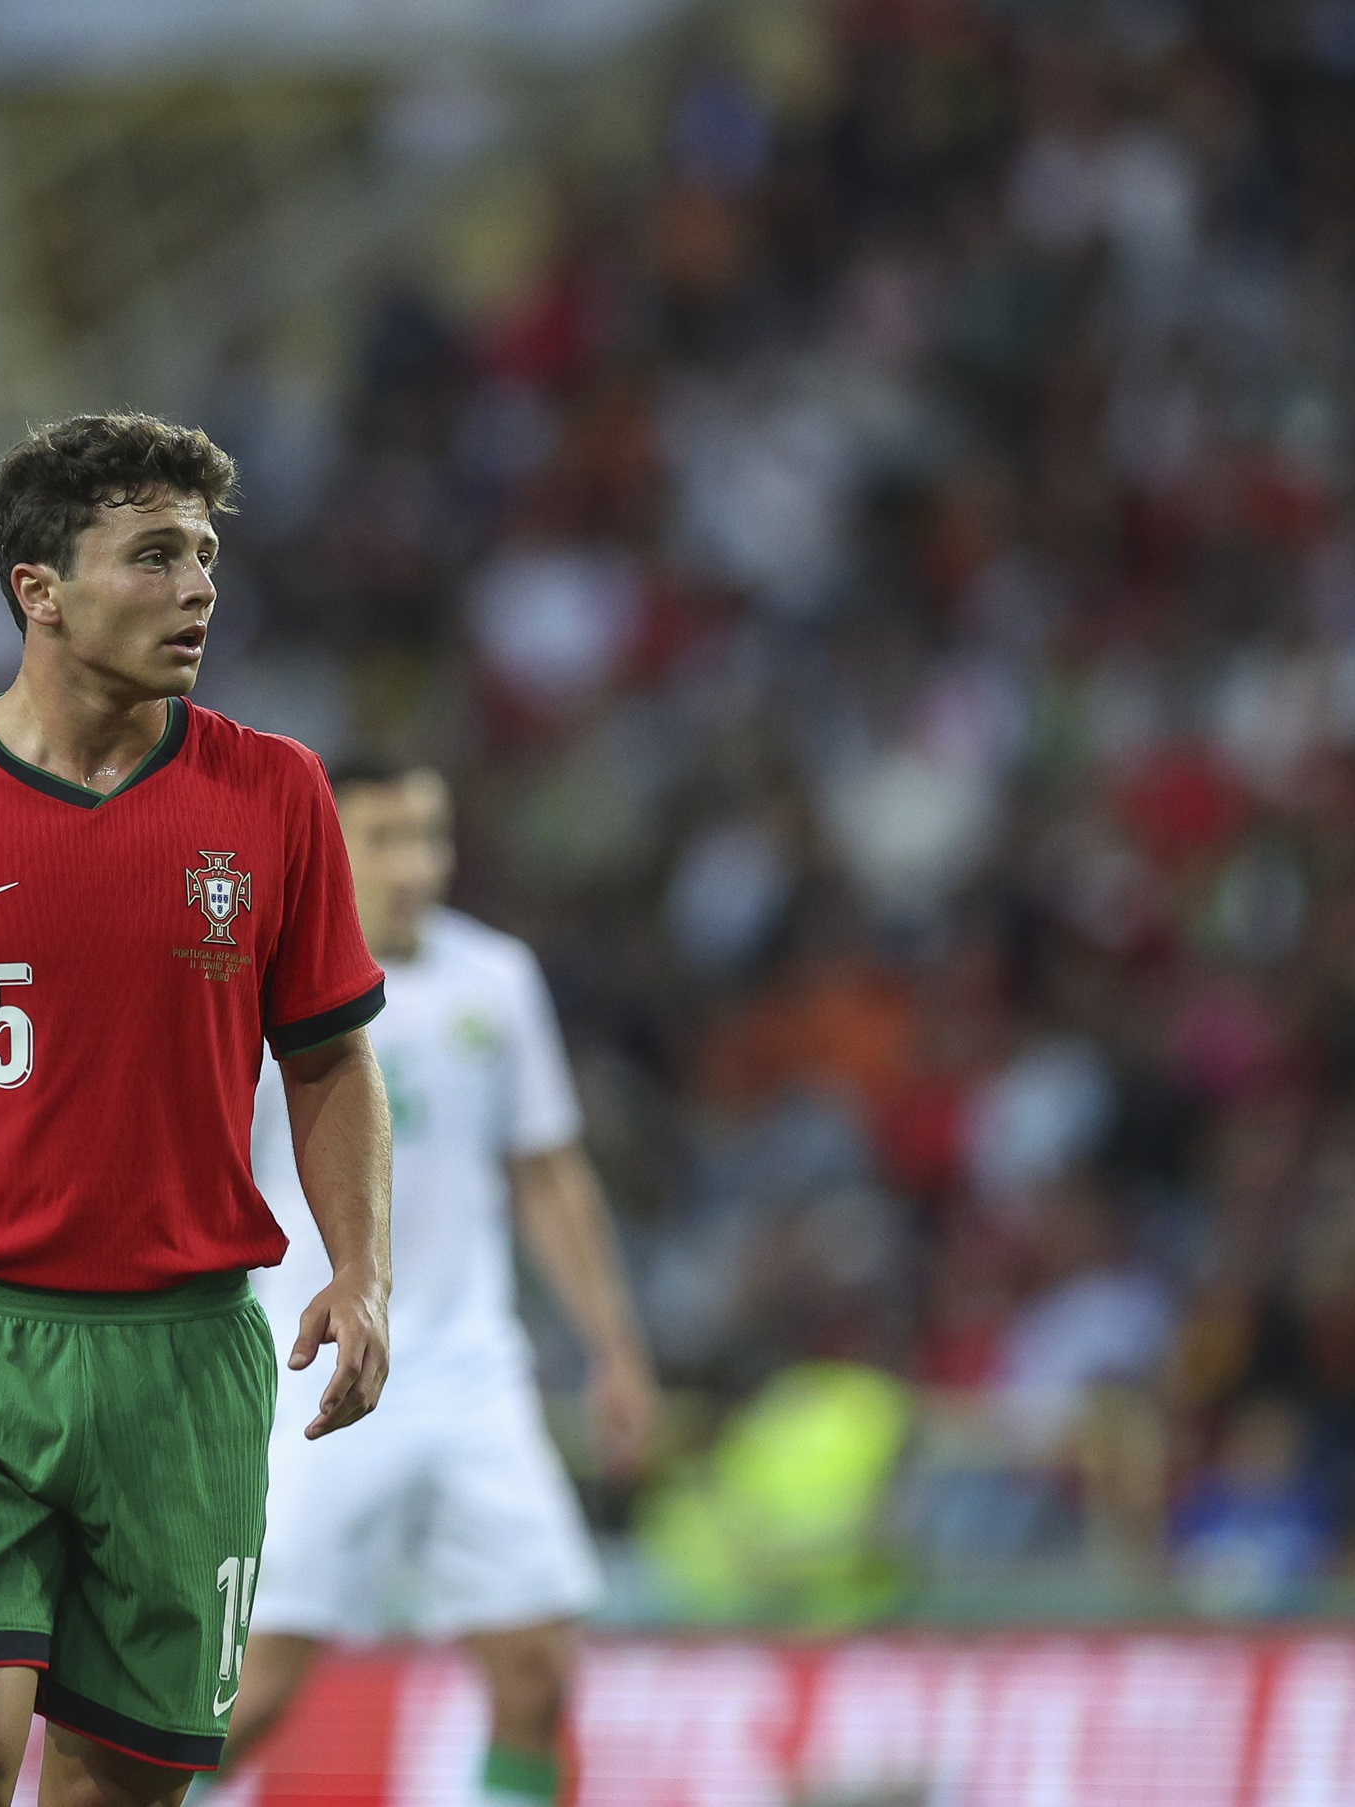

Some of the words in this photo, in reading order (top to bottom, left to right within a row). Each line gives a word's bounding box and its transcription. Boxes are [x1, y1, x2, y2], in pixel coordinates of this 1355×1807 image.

[190, 960, 196, 969] 11
[199, 960, 223, 971] JUNHO
[204, 971, 230, 982] AVEIRO
